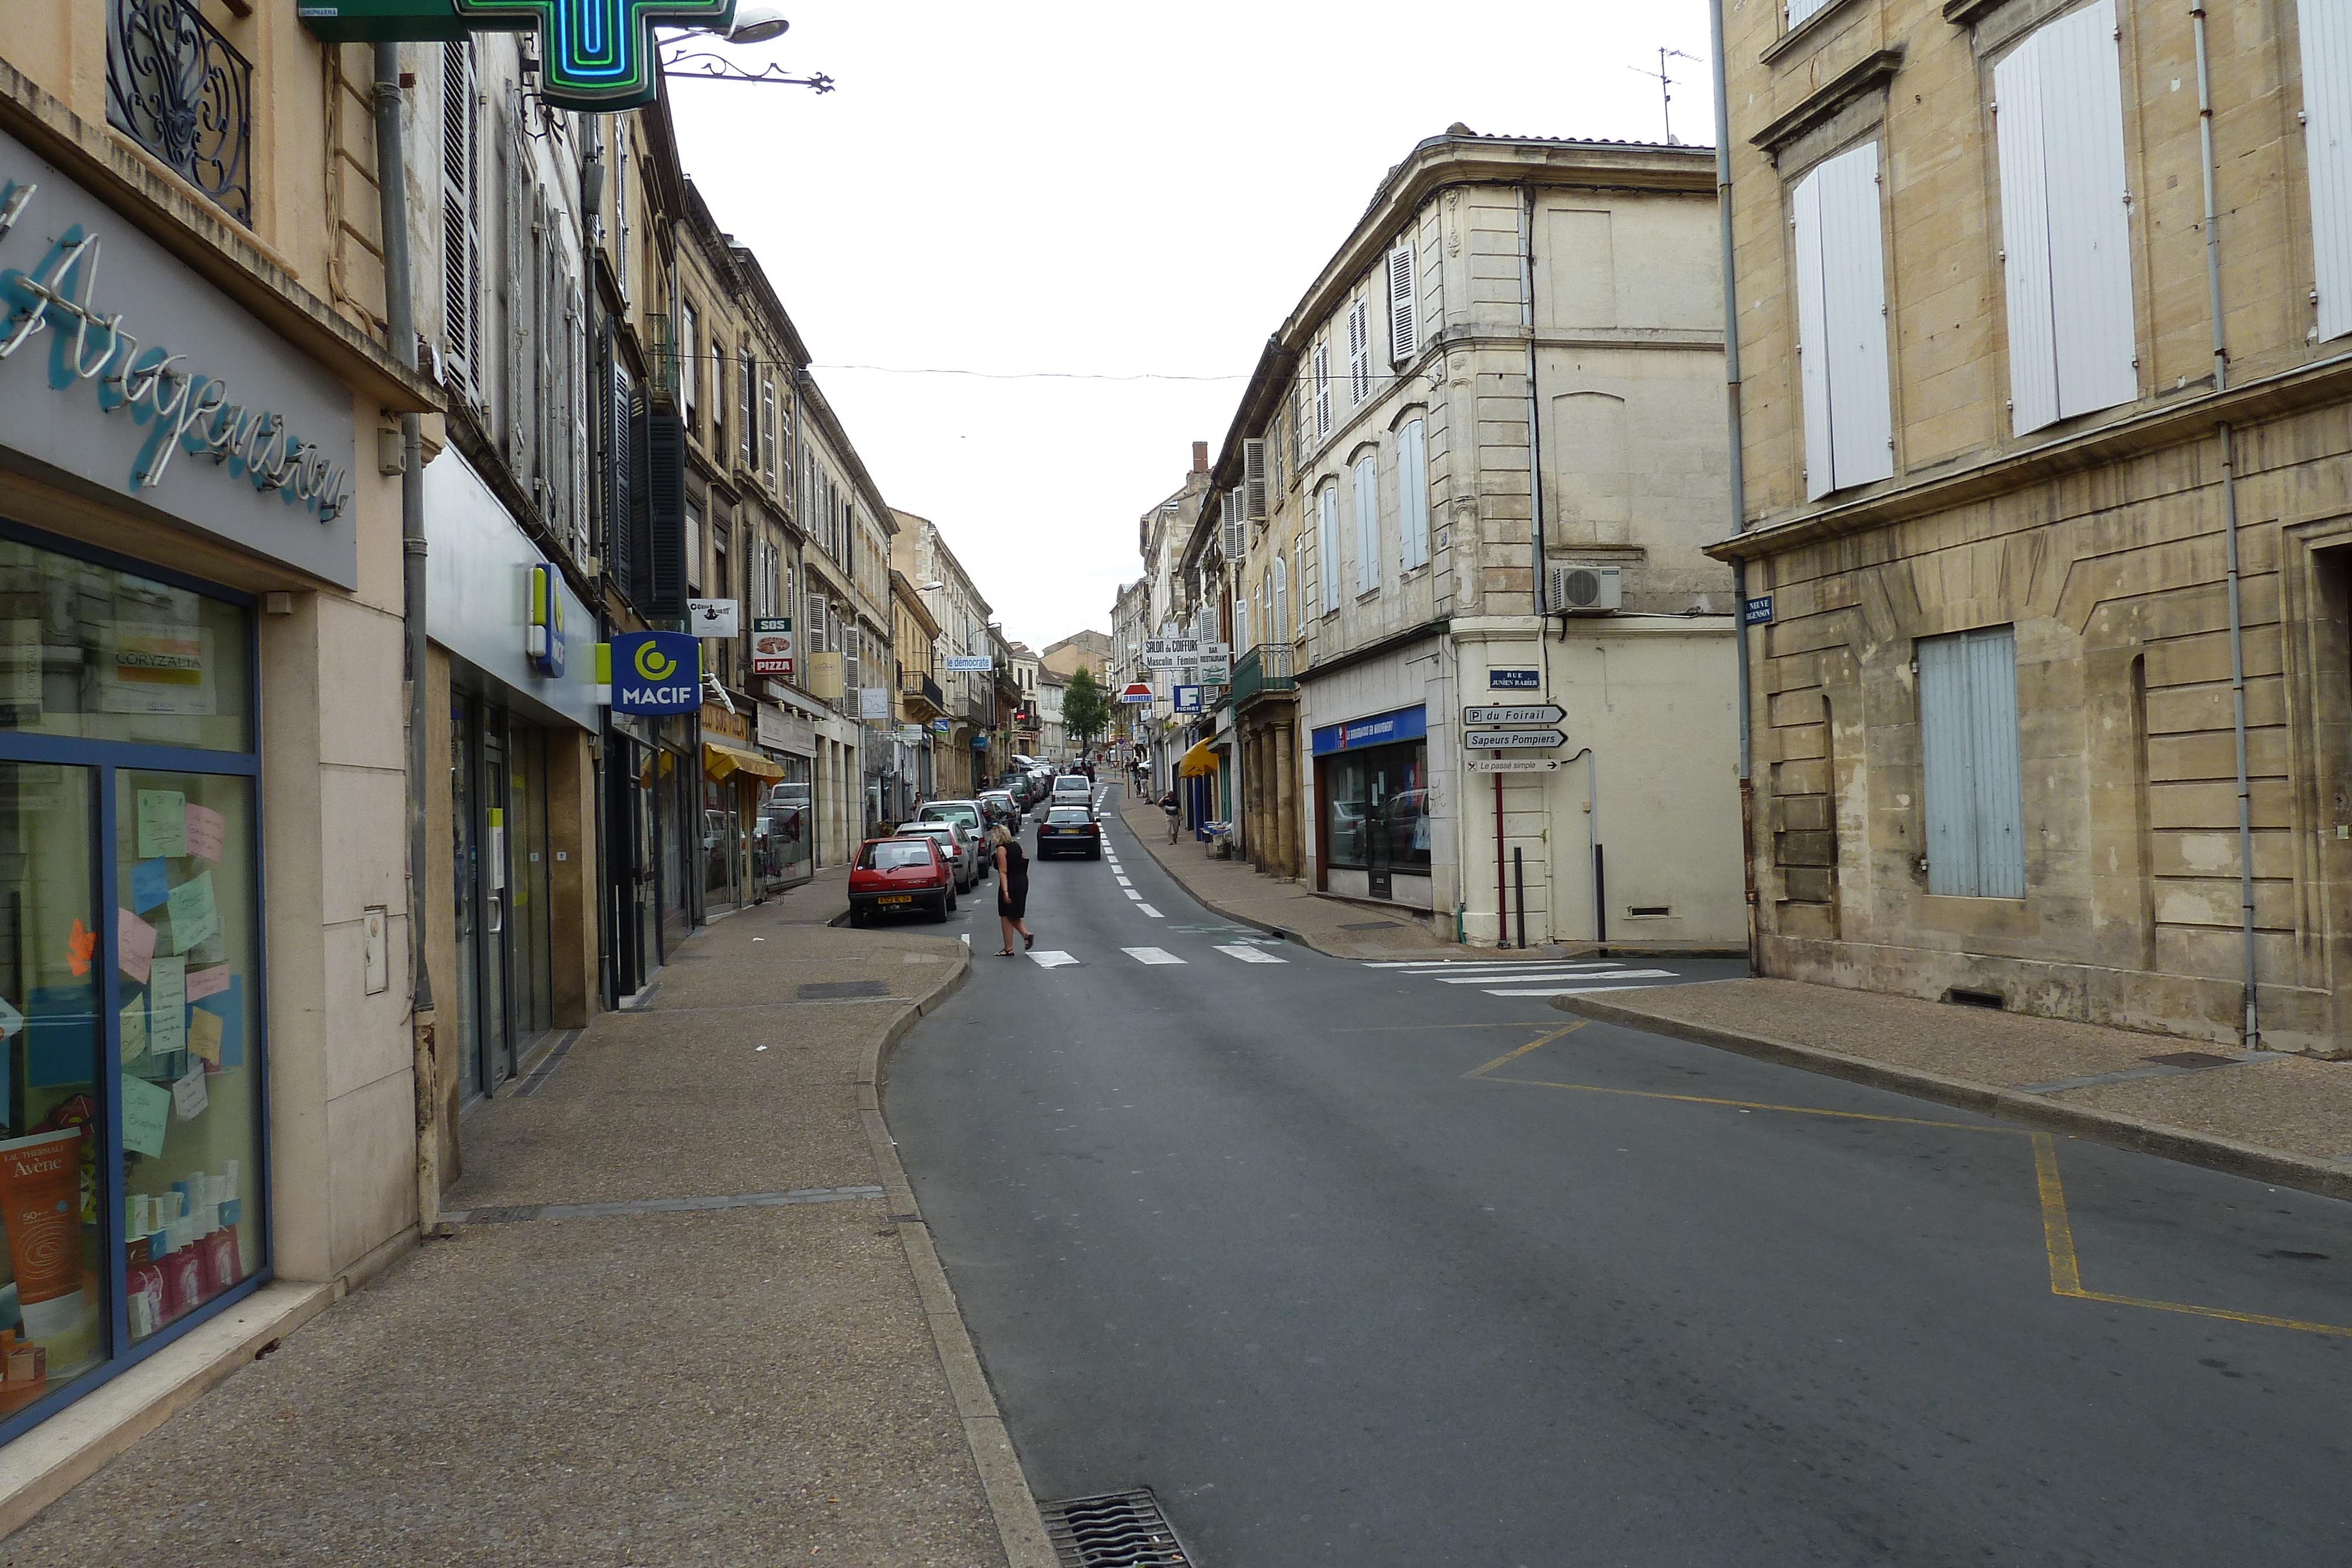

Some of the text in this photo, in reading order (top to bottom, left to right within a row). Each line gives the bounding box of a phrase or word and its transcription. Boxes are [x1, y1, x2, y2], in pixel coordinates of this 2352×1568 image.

[1749, 600, 1769, 610] NEUVE
[1746, 609, 1770, 620] RGENSON
[760, 620, 785, 630] SOS
[1146, 641, 1164, 653] SALON
[116, 653, 201, 668] CORYZALIA
[757, 661, 790, 671] PIZZA
[947, 657, 989, 667] le démocrate
[1147, 656, 1172, 667] Masculin
[622, 687, 692, 704] MACIF
[1472, 710, 1545, 720] P du Foirail
[1472, 735, 1555, 747] Sapeurs Pompiers
[1491, 762, 1512, 770] passé
[1513, 762, 1536, 770] simple
[4, 1145, 65, 1162] EAU THERMALE
[14, 1158, 62, 1178] Avène
